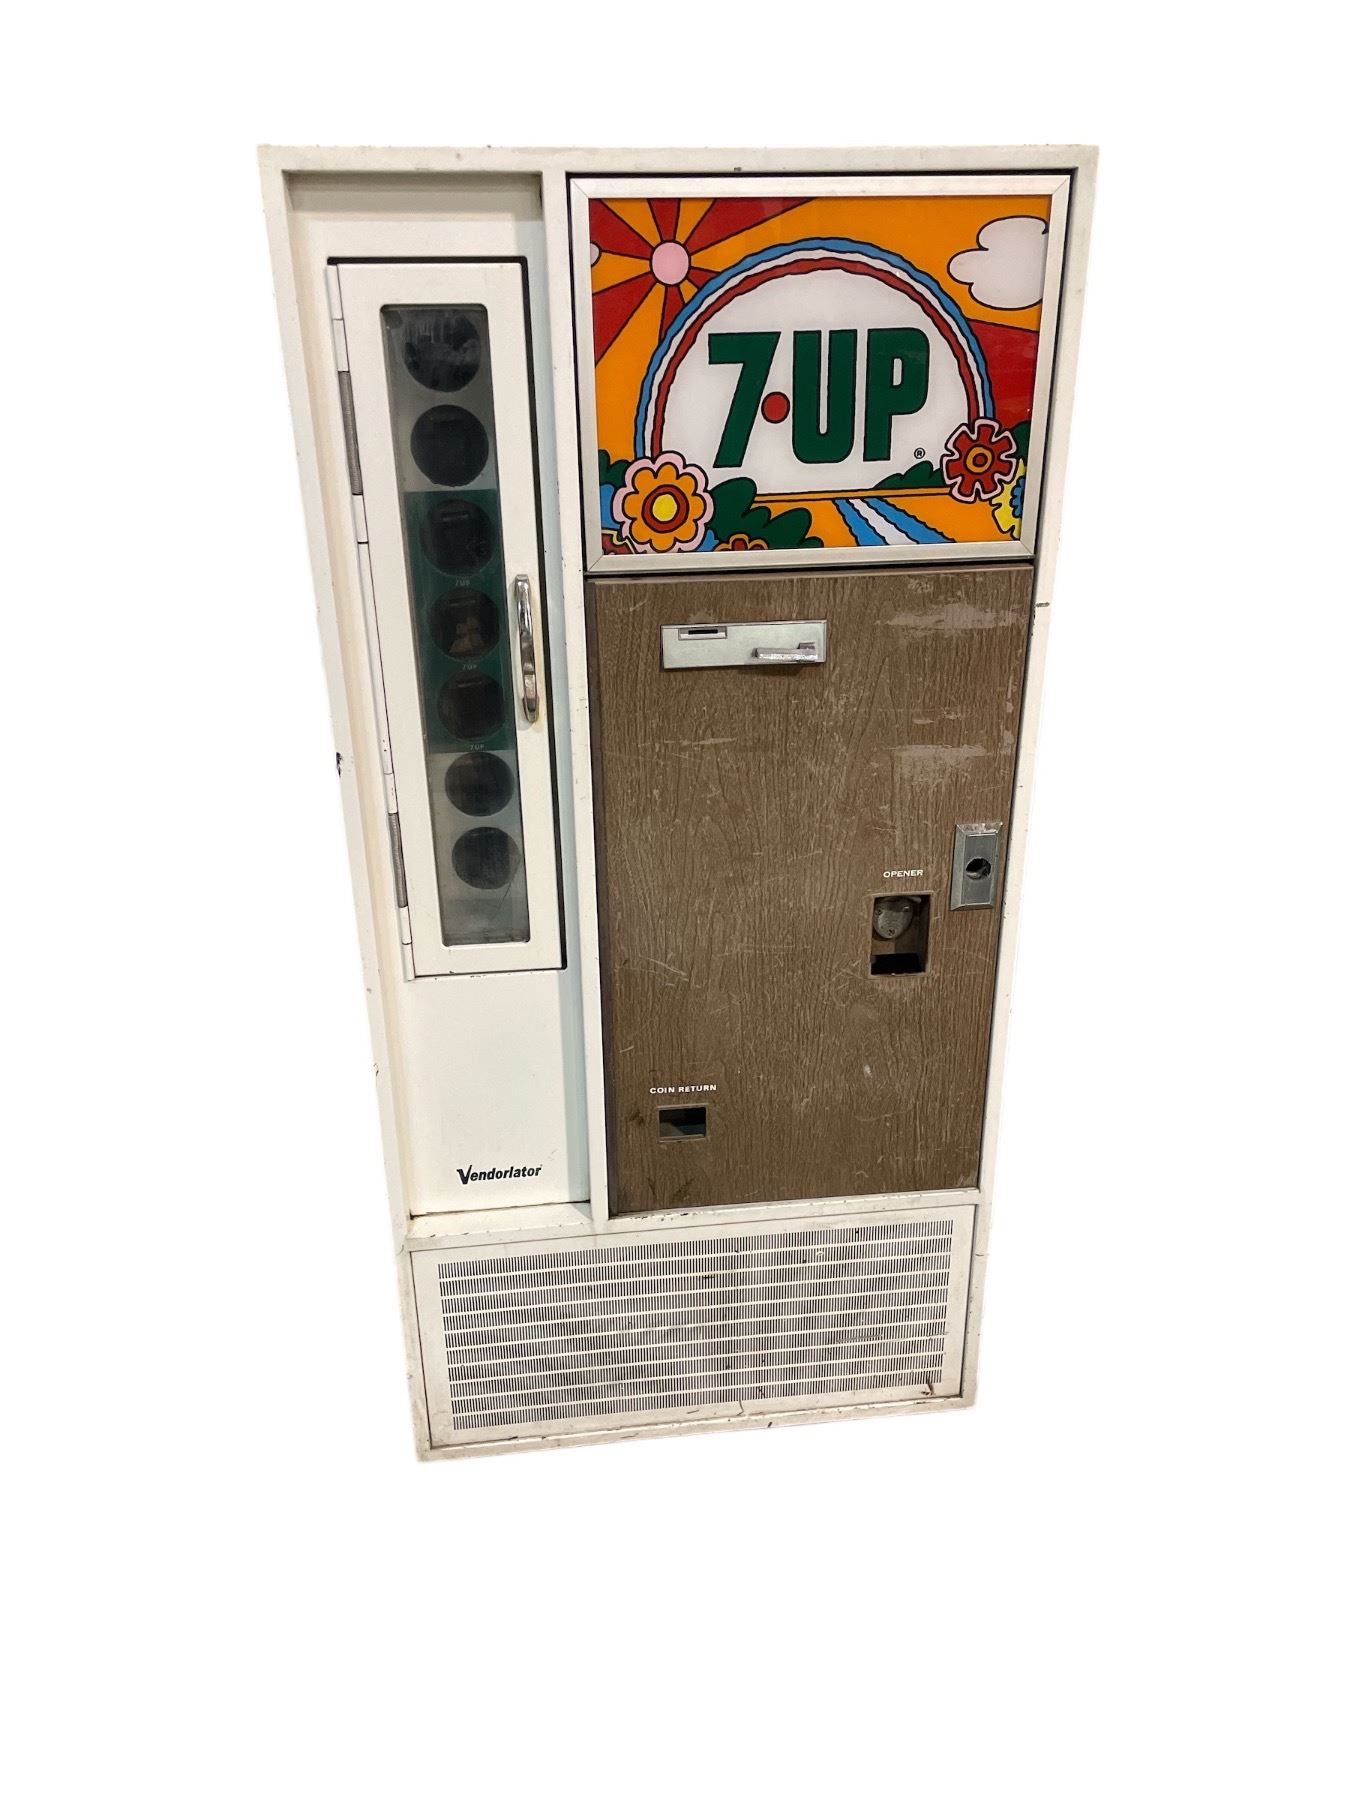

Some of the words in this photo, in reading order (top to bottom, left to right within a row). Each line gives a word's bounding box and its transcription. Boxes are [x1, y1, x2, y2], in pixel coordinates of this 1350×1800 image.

[883, 869, 924, 878] OPENER
[678, 1084, 717, 1093] RETURN
[456, 1164, 542, 1185] Vendorlator
